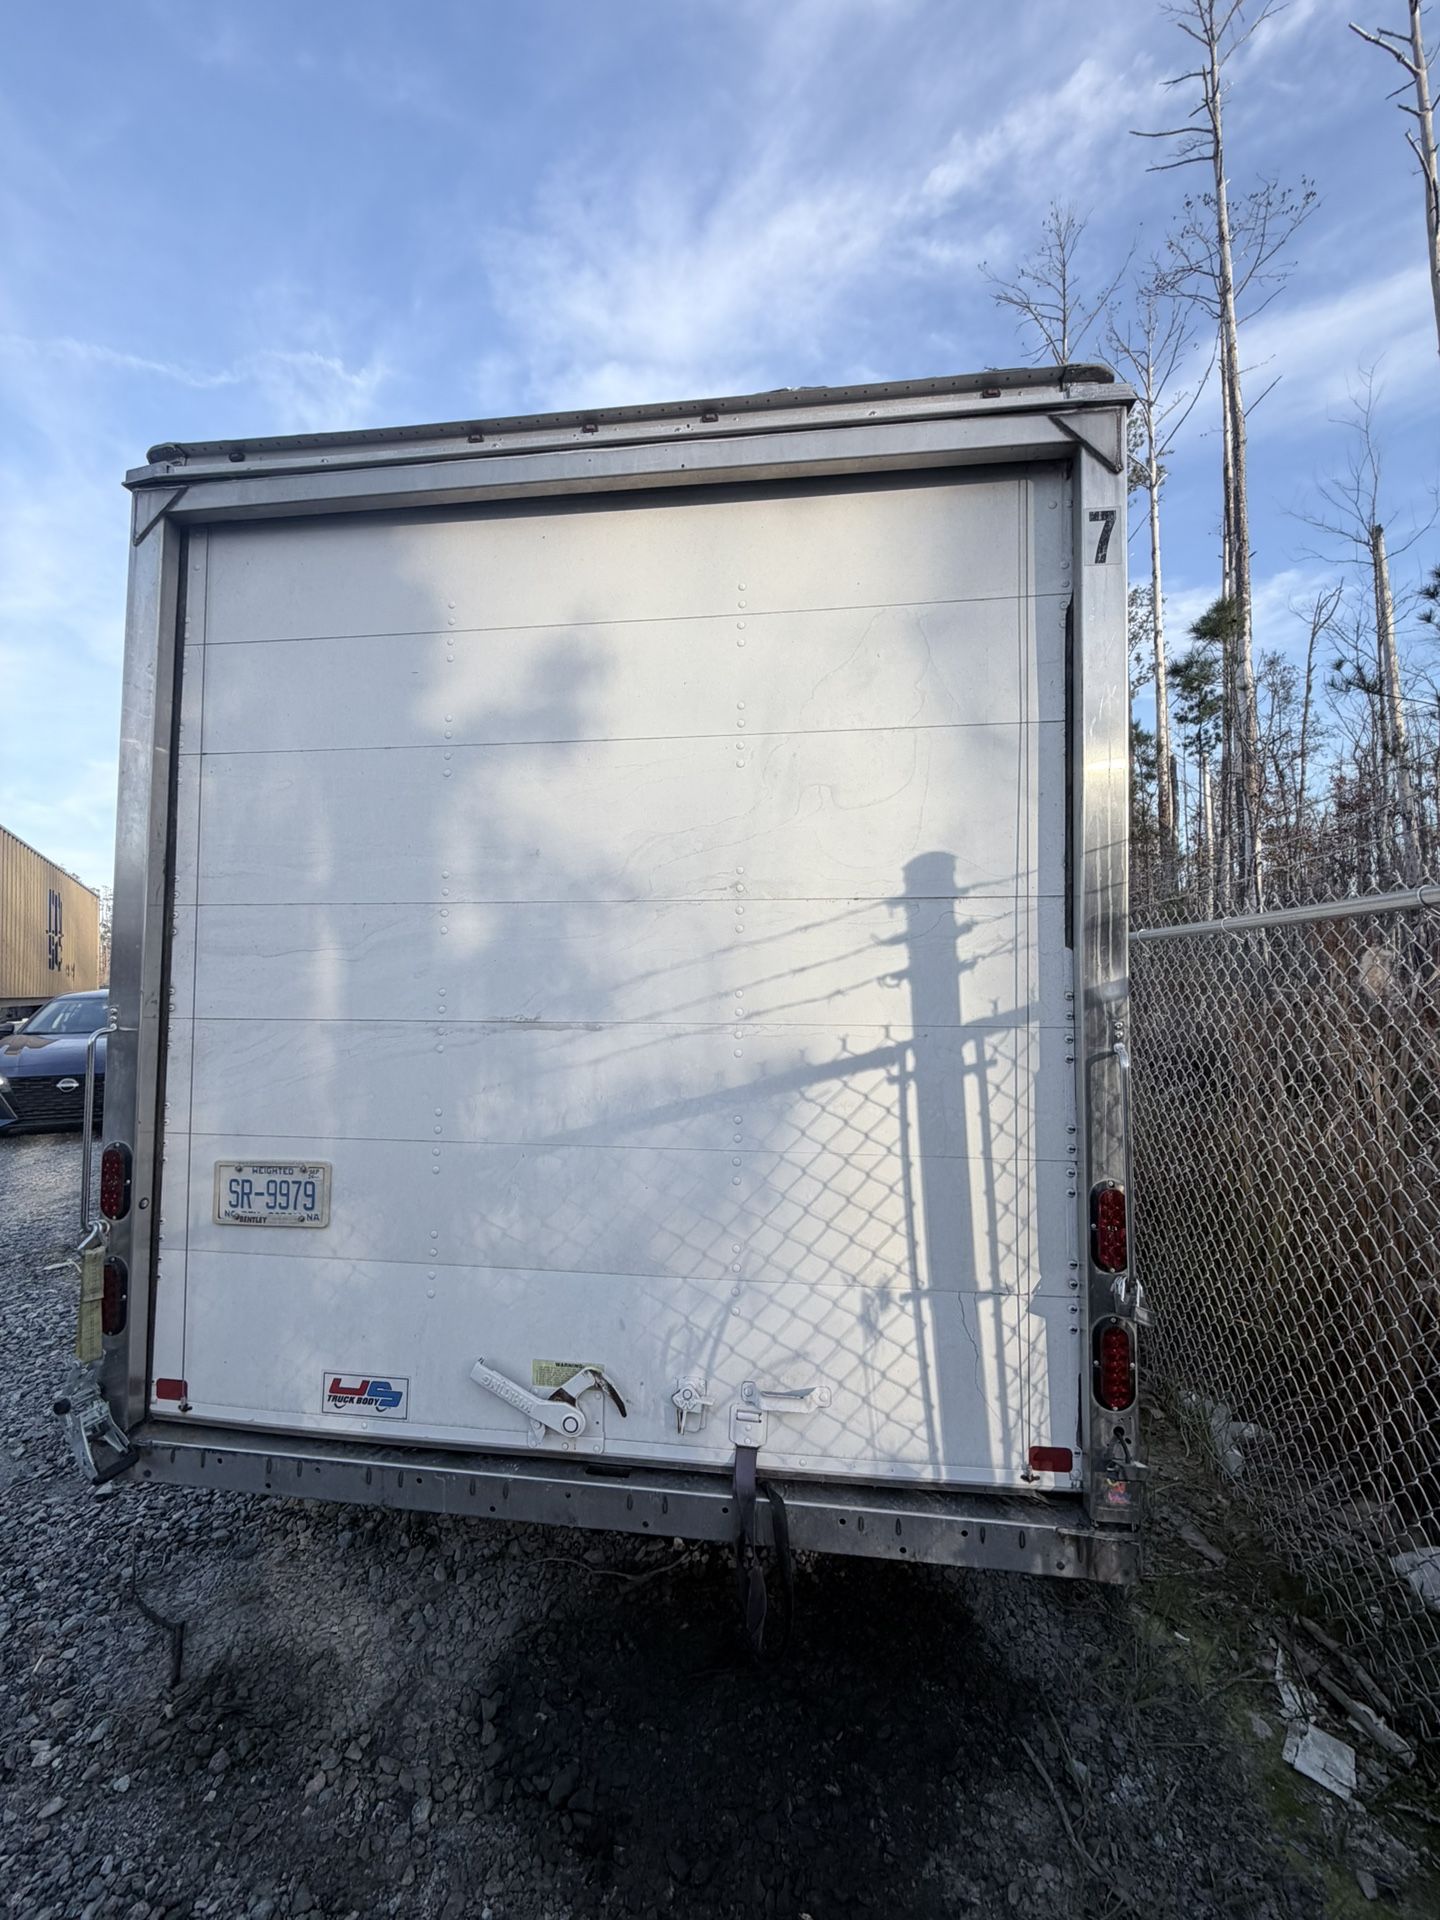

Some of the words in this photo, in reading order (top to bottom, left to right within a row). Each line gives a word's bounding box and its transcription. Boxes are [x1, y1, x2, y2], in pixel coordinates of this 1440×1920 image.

[1089, 510, 1117, 564] 7
[252, 1167, 294, 1175] WEIGHTED
[228, 1178, 316, 1211] SR-9979
[239, 1215, 268, 1224] BENTLEY
[327, 1394, 356, 1404] TRUCK
[356, 1396, 380, 1407] BODY
[328, 1377, 404, 1408] US
